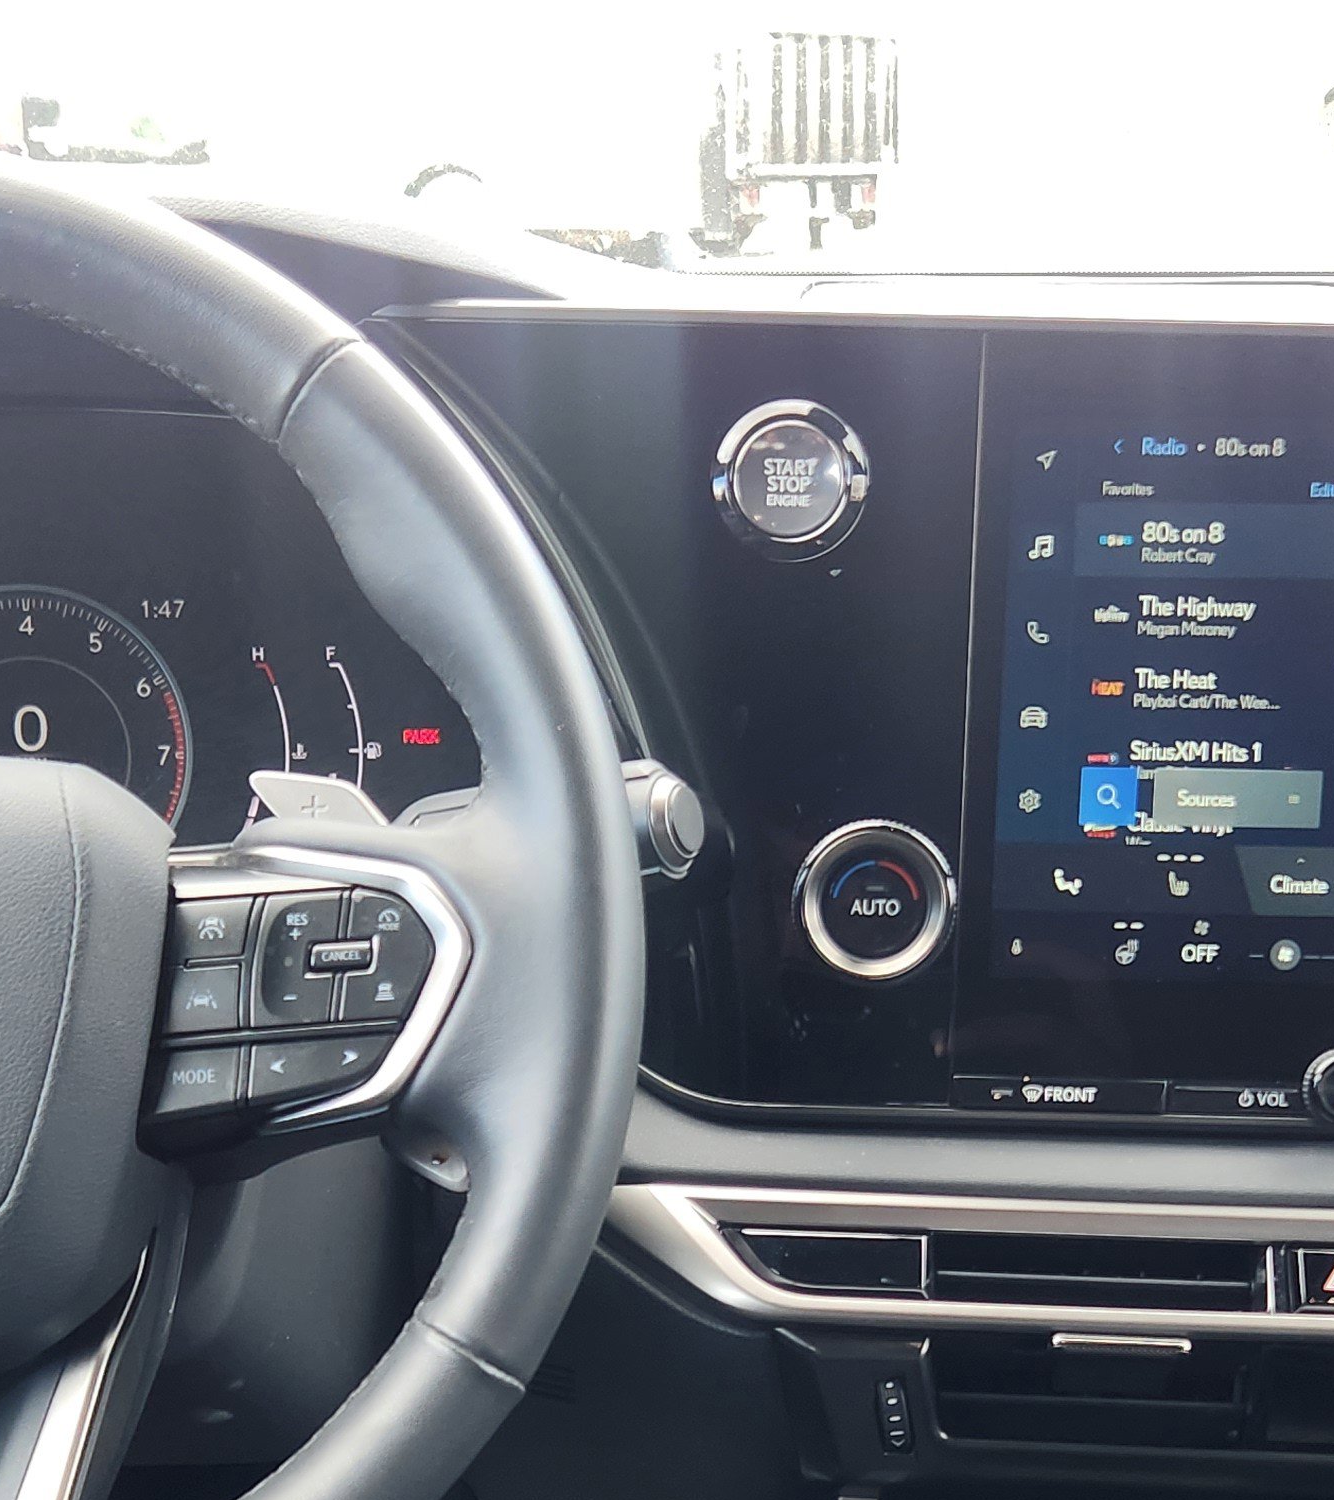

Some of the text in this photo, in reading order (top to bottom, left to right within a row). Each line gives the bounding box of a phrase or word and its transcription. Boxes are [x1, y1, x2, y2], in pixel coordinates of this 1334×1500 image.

[1141, 436, 1287, 458] Radio 80s on 8
[763, 457, 818, 476] START
[766, 475, 814, 494] STOP
[1102, 481, 1155, 498] Favorites
[766, 493, 813, 508] ENGINE
[1141, 521, 1180, 544] 80s
[1181, 527, 1207, 544] on
[1207, 521, 1226, 545] 8
[1141, 547, 1216, 566] Robert Cray
[141, 600, 186, 620] 1:47
[1138, 594, 1175, 617] The
[1176, 595, 1257, 621] Highway
[19, 615, 35, 636] 4
[1136, 620, 1238, 640] Megan Moroney
[89, 632, 103, 654] 5
[325, 645, 337, 660] F
[251, 646, 265, 661] H
[137, 677, 151, 698] 6
[1134, 667, 1218, 690] The Heat
[1133, 693, 1178, 711] Playboi
[13, 704, 48, 753] 0
[402, 728, 441, 744] PARK
[157, 745, 171, 766] 7
[1129, 739, 1210, 762] SiriusXM
[1211, 741, 1249, 763] Hits
[1251, 741, 1263, 763] 1
[1176, 788, 1237, 808] Sources
[1269, 873, 1331, 896] Climate
[849, 897, 903, 918] AUTO
[286, 912, 309, 926] RES
[321, 950, 361, 962] CANCEL
[1180, 943, 1221, 964] OFF
[172, 1068, 216, 1085] MODE
[1043, 1085, 1098, 1105] FRONT
[1257, 1091, 1289, 1108] VOL
